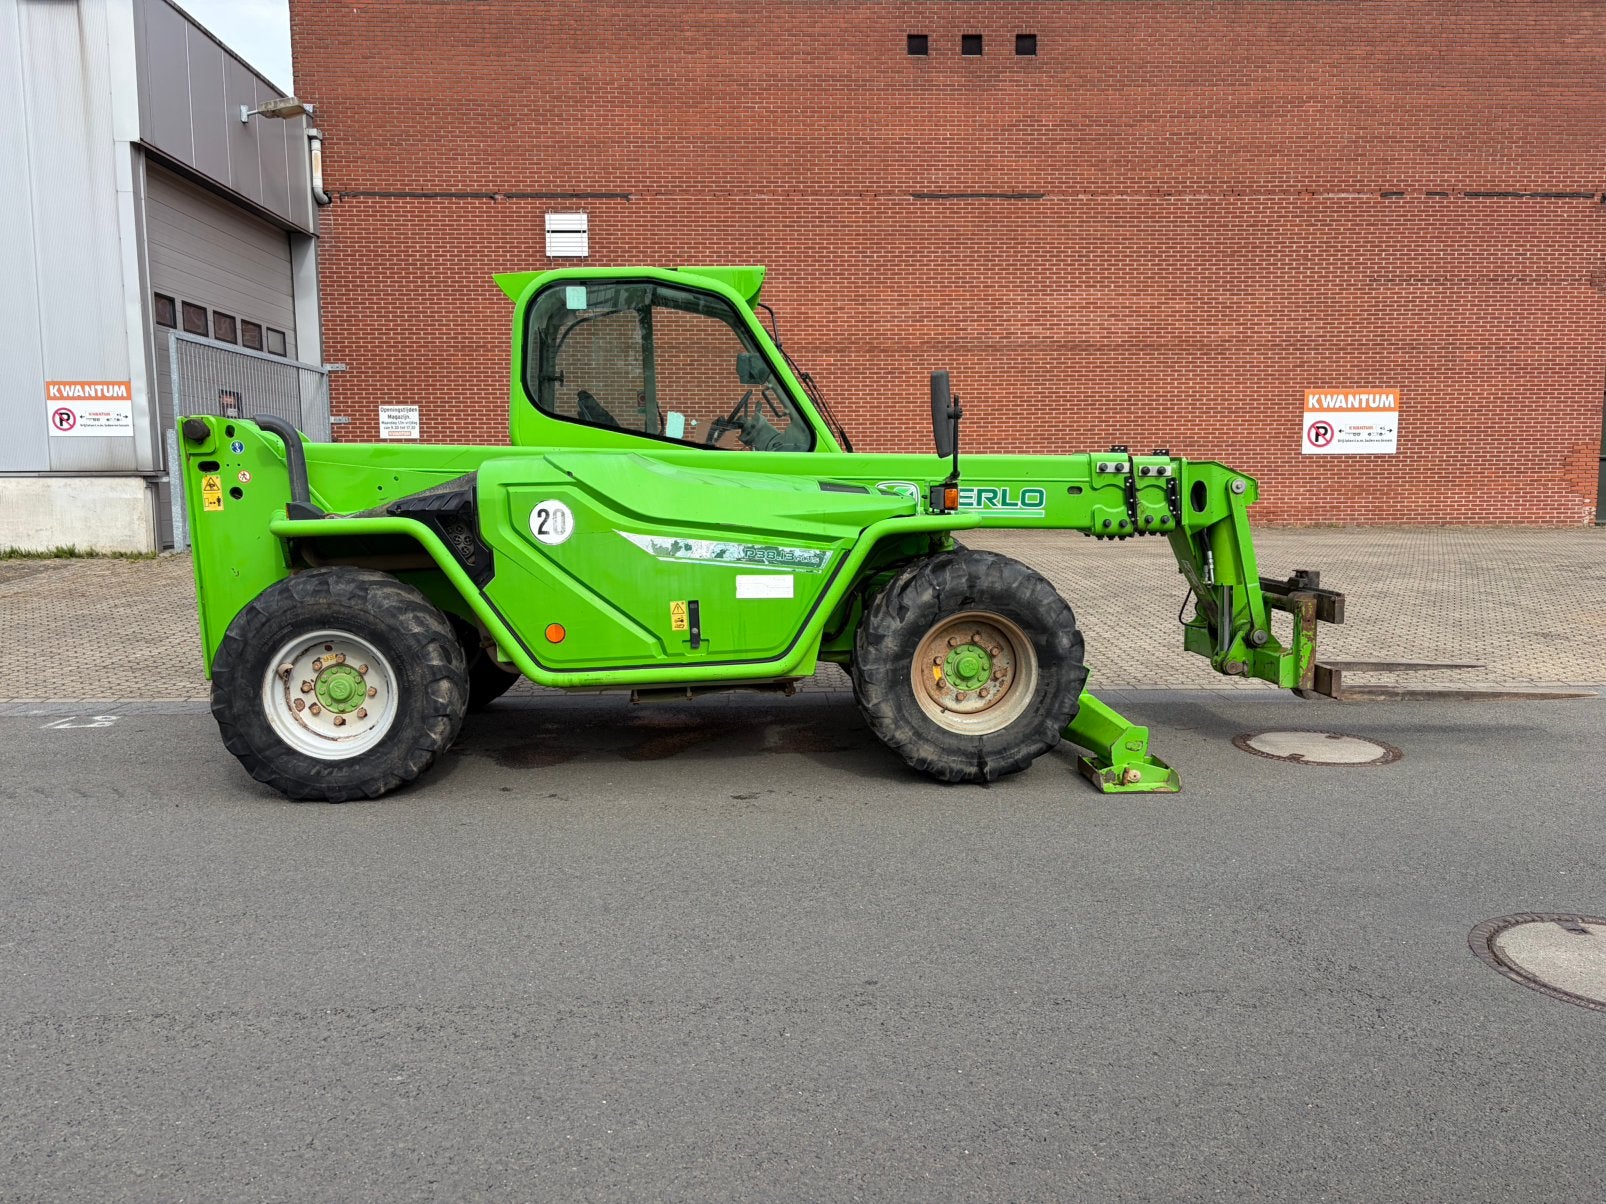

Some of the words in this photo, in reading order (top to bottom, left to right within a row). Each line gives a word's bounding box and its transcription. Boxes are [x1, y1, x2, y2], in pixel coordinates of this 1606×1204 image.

[49, 384, 127, 397] KWANTUM
[1308, 393, 1395, 408] KWANTUM
[957, 487, 1046, 508] ERLO
[537, 508, 566, 535] 20
[743, 548, 795, 562] P38.13
